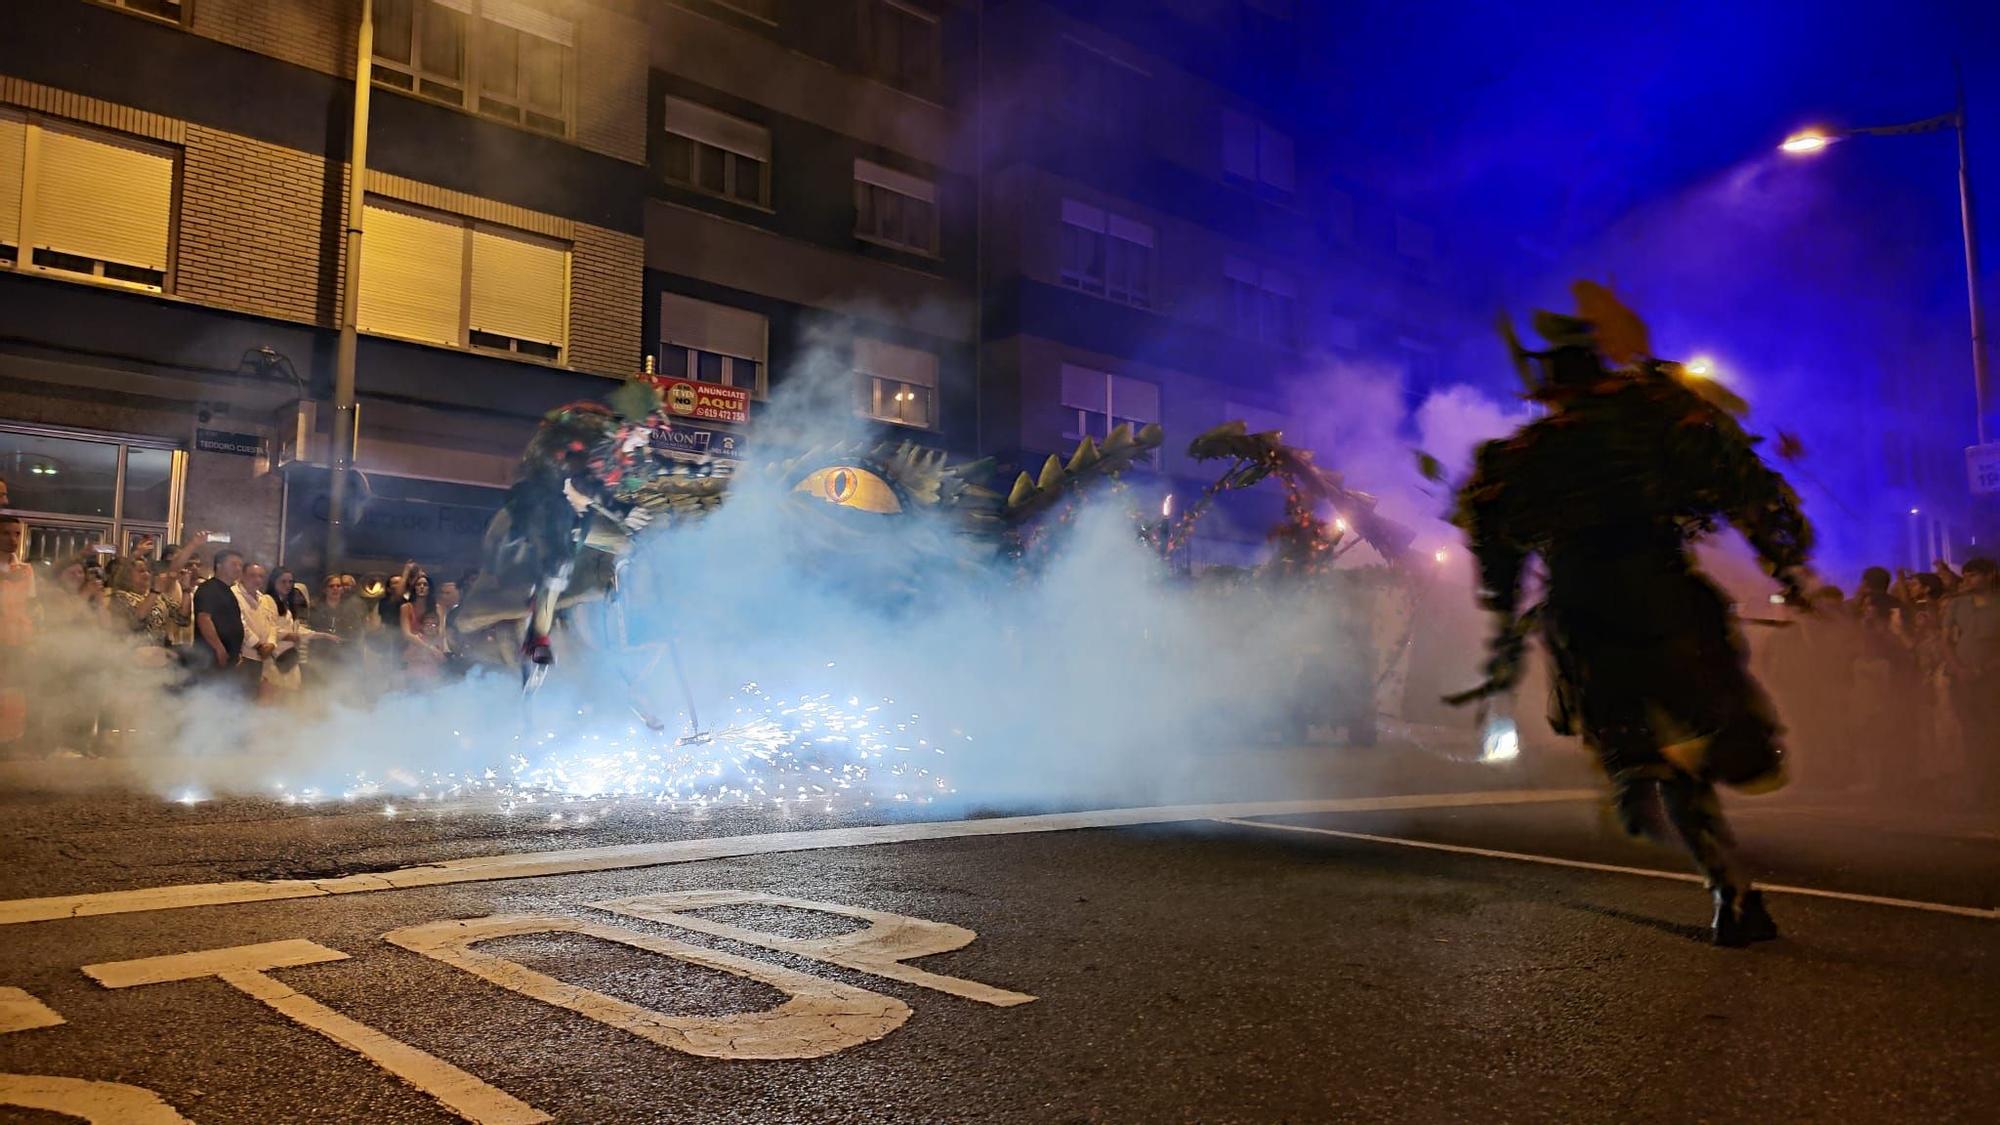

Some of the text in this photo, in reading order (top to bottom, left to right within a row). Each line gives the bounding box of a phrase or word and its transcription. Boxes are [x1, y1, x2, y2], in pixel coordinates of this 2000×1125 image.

[675, 397, 691, 405] NO
[704, 408, 718, 418] 619
[719, 409, 731, 420] 472
[200, 440, 236, 451] TEODORO
